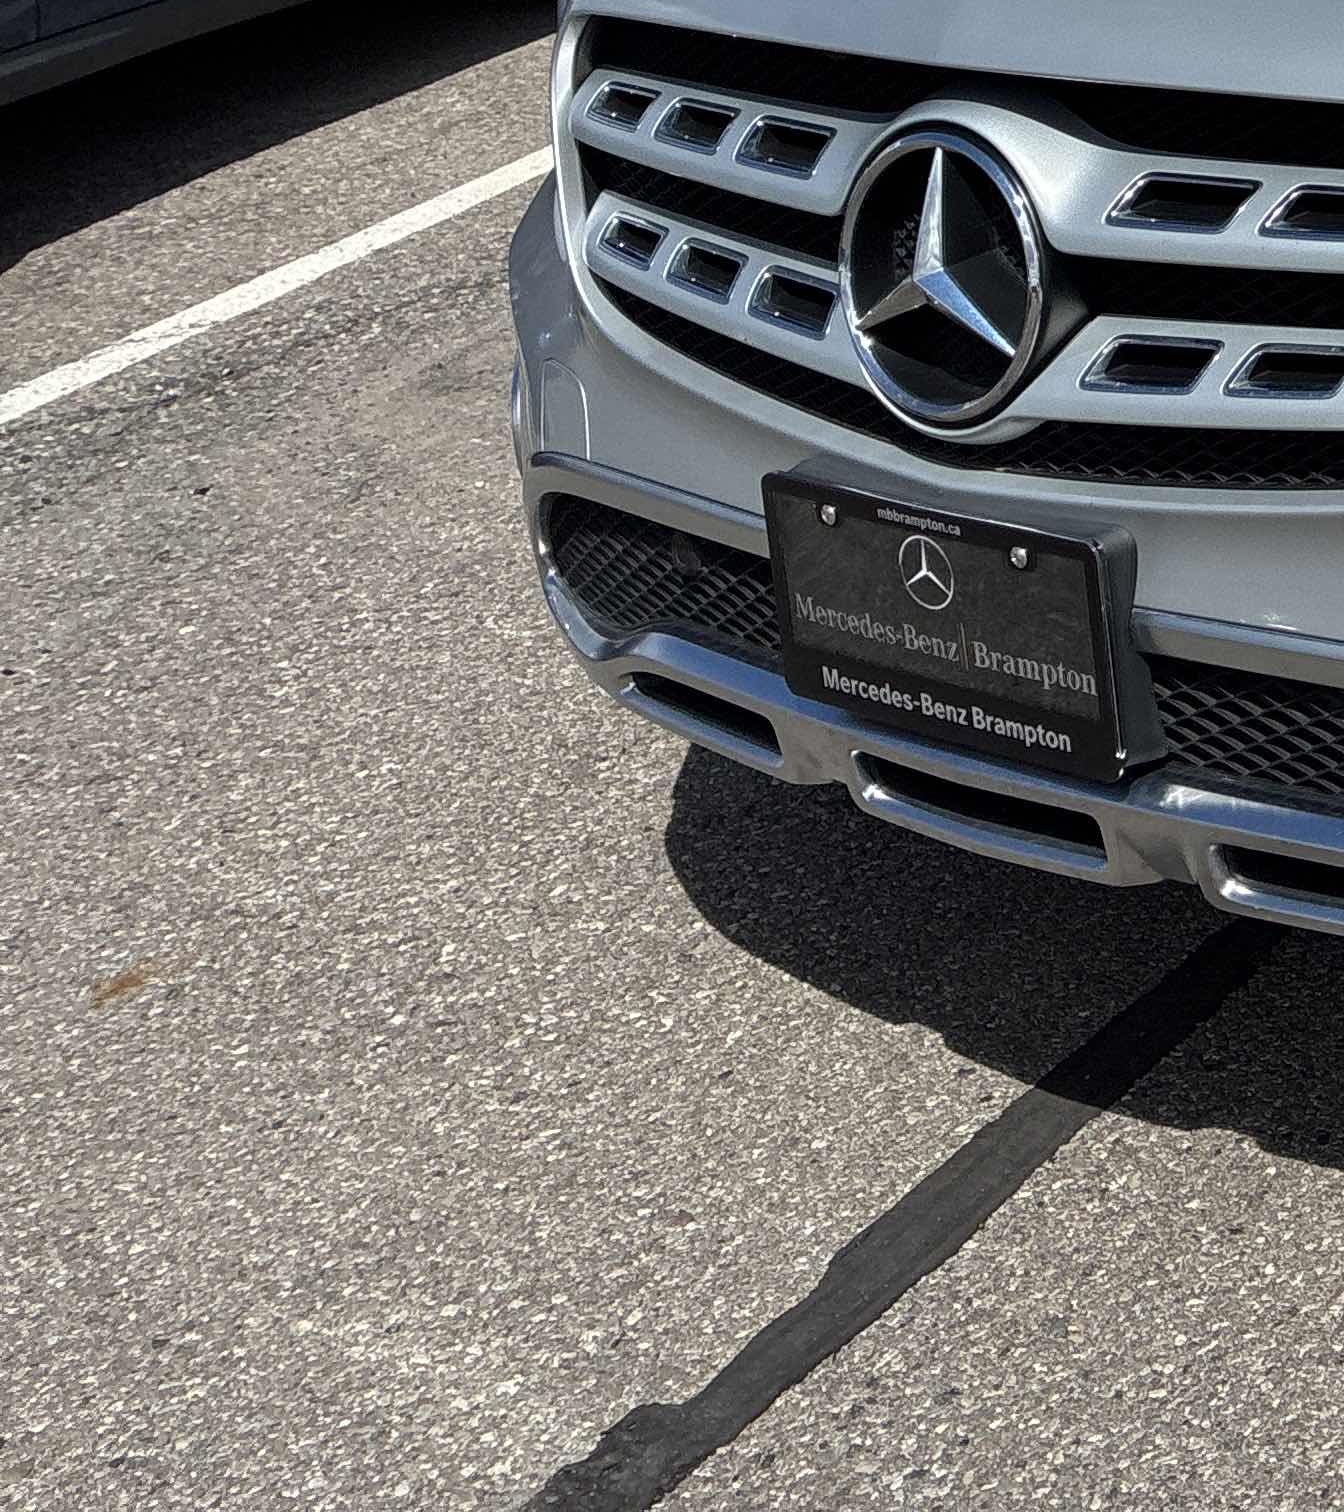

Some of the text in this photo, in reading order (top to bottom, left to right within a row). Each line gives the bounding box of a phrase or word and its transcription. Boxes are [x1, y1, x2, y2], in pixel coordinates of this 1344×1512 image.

[877, 508, 961, 536] mbbrampton.ca
[795, 593, 1098, 697] Mercedes-Benz Brampton
[822, 665, 1072, 753] Mercedes-Benz Brampton
